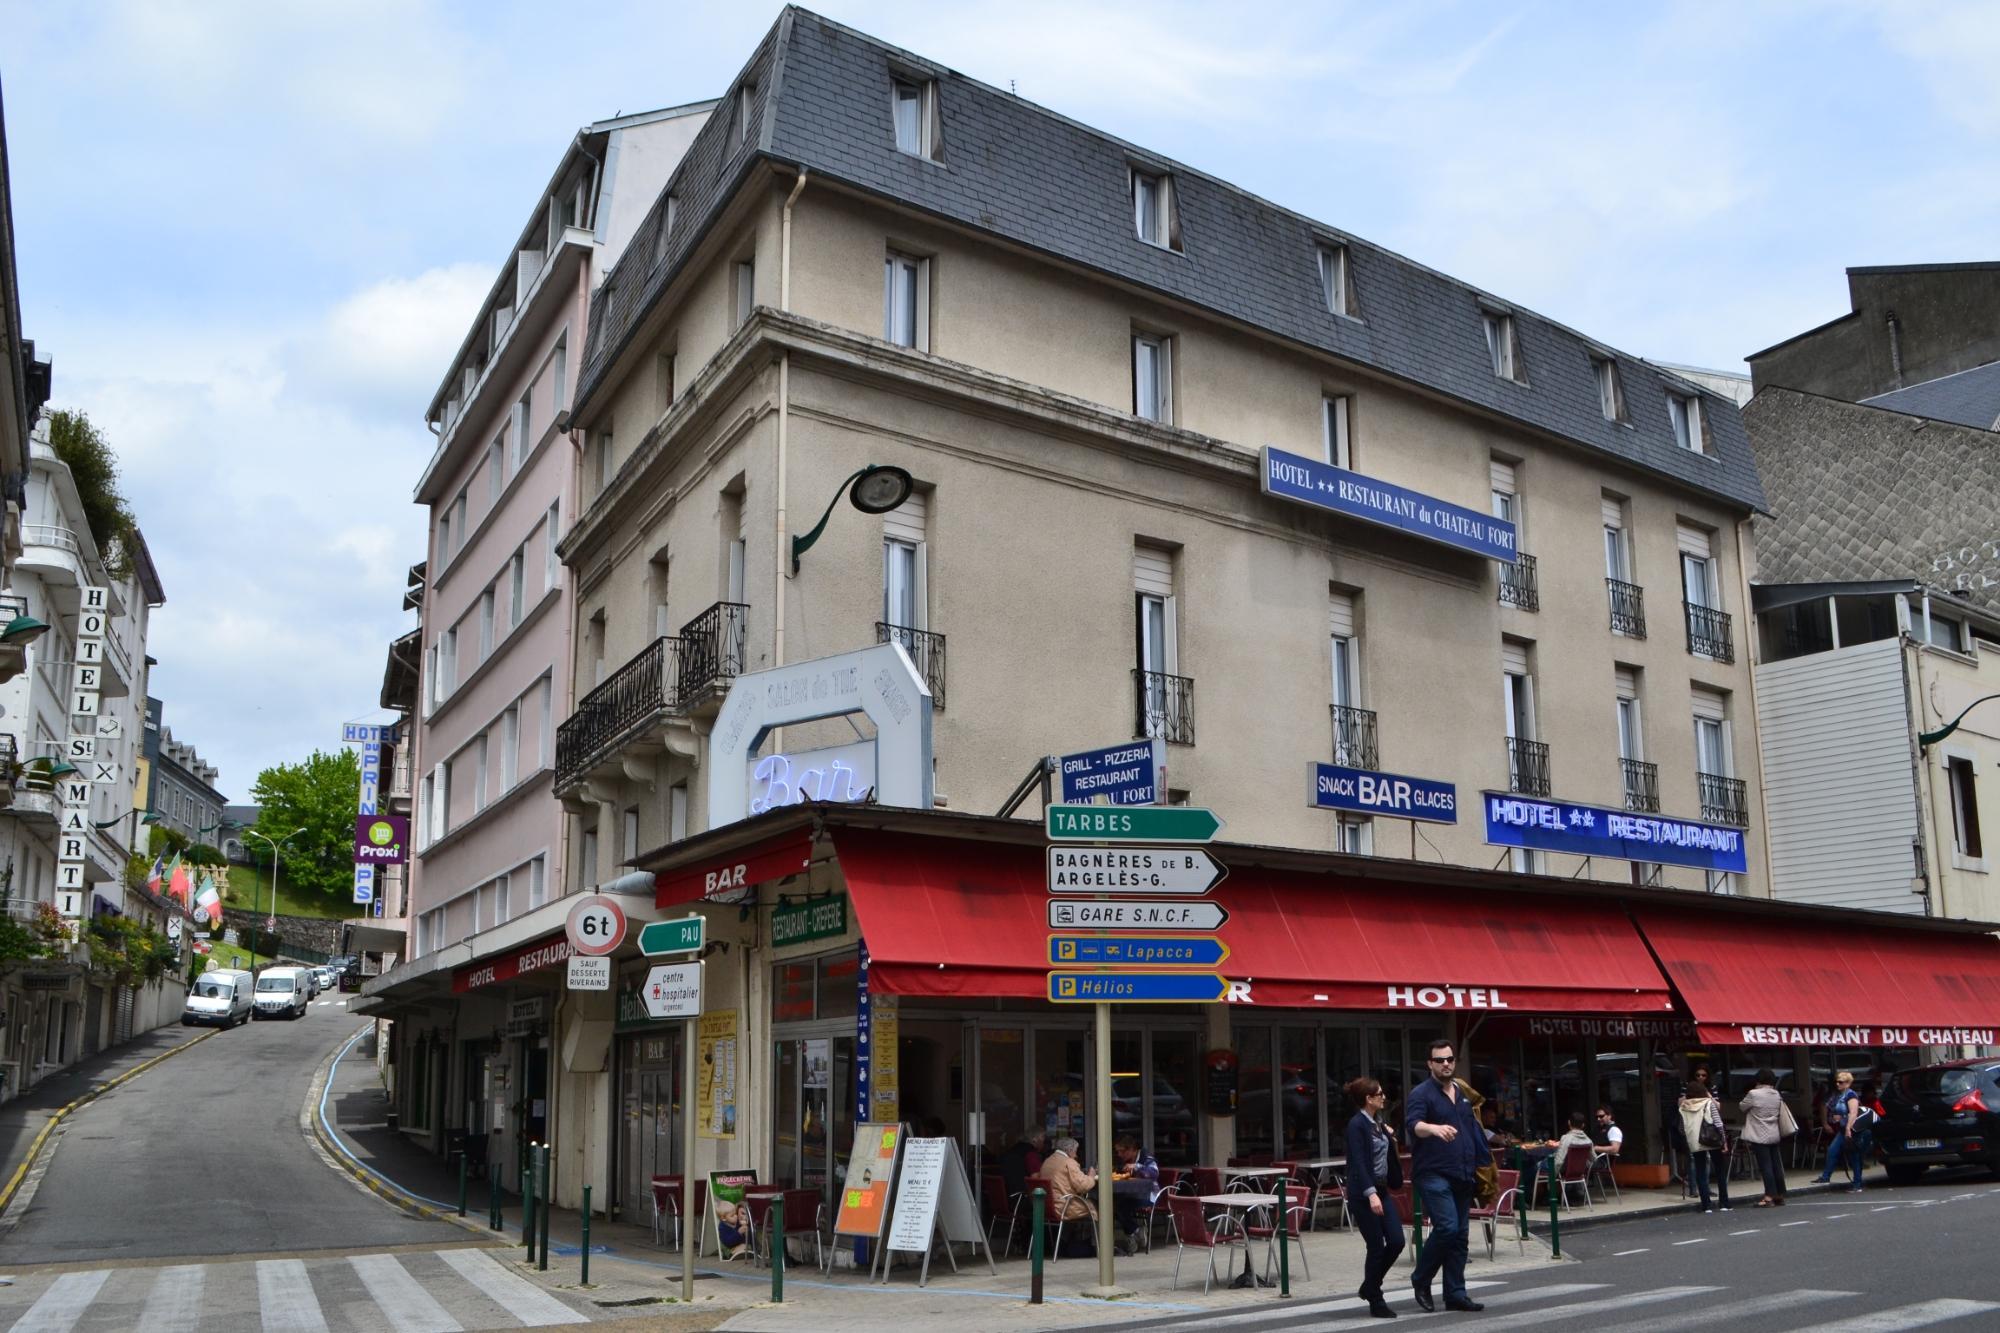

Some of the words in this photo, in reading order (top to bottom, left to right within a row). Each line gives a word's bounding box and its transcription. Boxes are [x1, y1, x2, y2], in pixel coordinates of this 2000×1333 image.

[1271, 459, 1313, 489] HOTEL
[1339, 480, 1417, 519] RESTAURANT
[1419, 505, 1431, 524] du
[1434, 509, 1485, 540] CHATEAU
[1488, 526, 1514, 549] FORT
[78, 590, 103, 712] HOTEL
[346, 726, 400, 742] HOTEL
[71, 740, 93, 756] St
[1064, 759, 1092, 774] GRILL
[1105, 747, 1151, 766] PIZZERIA
[752, 755, 866, 813] Bar
[1076, 768, 1140, 790] RESTAURANT
[1123, 786, 1153, 803] FORT
[1318, 776, 1355, 797] SNACK
[1359, 776, 1411, 810] BAR
[1414, 789, 1454, 810] GLACES
[1056, 814, 1132, 831] TARBES
[1491, 798, 1567, 830] HOTEL
[1608, 814, 1740, 852] RESTAURANT
[359, 844, 398, 858] Proxi
[1056, 852, 1152, 868] BAGNÈRES
[1162, 860, 1175, 869] DE
[1185, 856, 1199, 869] B.
[705, 864, 747, 894] BAR
[1057, 870, 1166, 886] ARGELÈS-G.
[1080, 908, 1124, 921] GARE
[1133, 909, 1194, 922] S.N.C.F.
[772, 910, 808, 940] RESTAURANT
[681, 926, 699, 943] PAU
[1128, 944, 1193, 960] Lapacca
[469, 967, 496, 988] HOTEL
[571, 969, 606, 977] DESSERTE
[662, 972, 684, 983] centre
[569, 979, 607, 987] RIVERAINS
[1082, 980, 1134, 994] Hélios
[662, 987, 698, 1003] hospitalier
[1220, 981, 1254, 1002] R
[1388, 986, 1508, 1008] HOTEL
[1530, 1018, 1577, 1035] HOTEL
[1581, 1020, 1602, 1036] DU
[1606, 1020, 1669, 1037] CHATEAU
[1742, 1026, 1871, 1044] RESTAURANT
[1882, 1028, 1908, 1044] DU
[1918, 1028, 1994, 1045] CHATEAU
[648, 1042, 664, 1059] BAR
